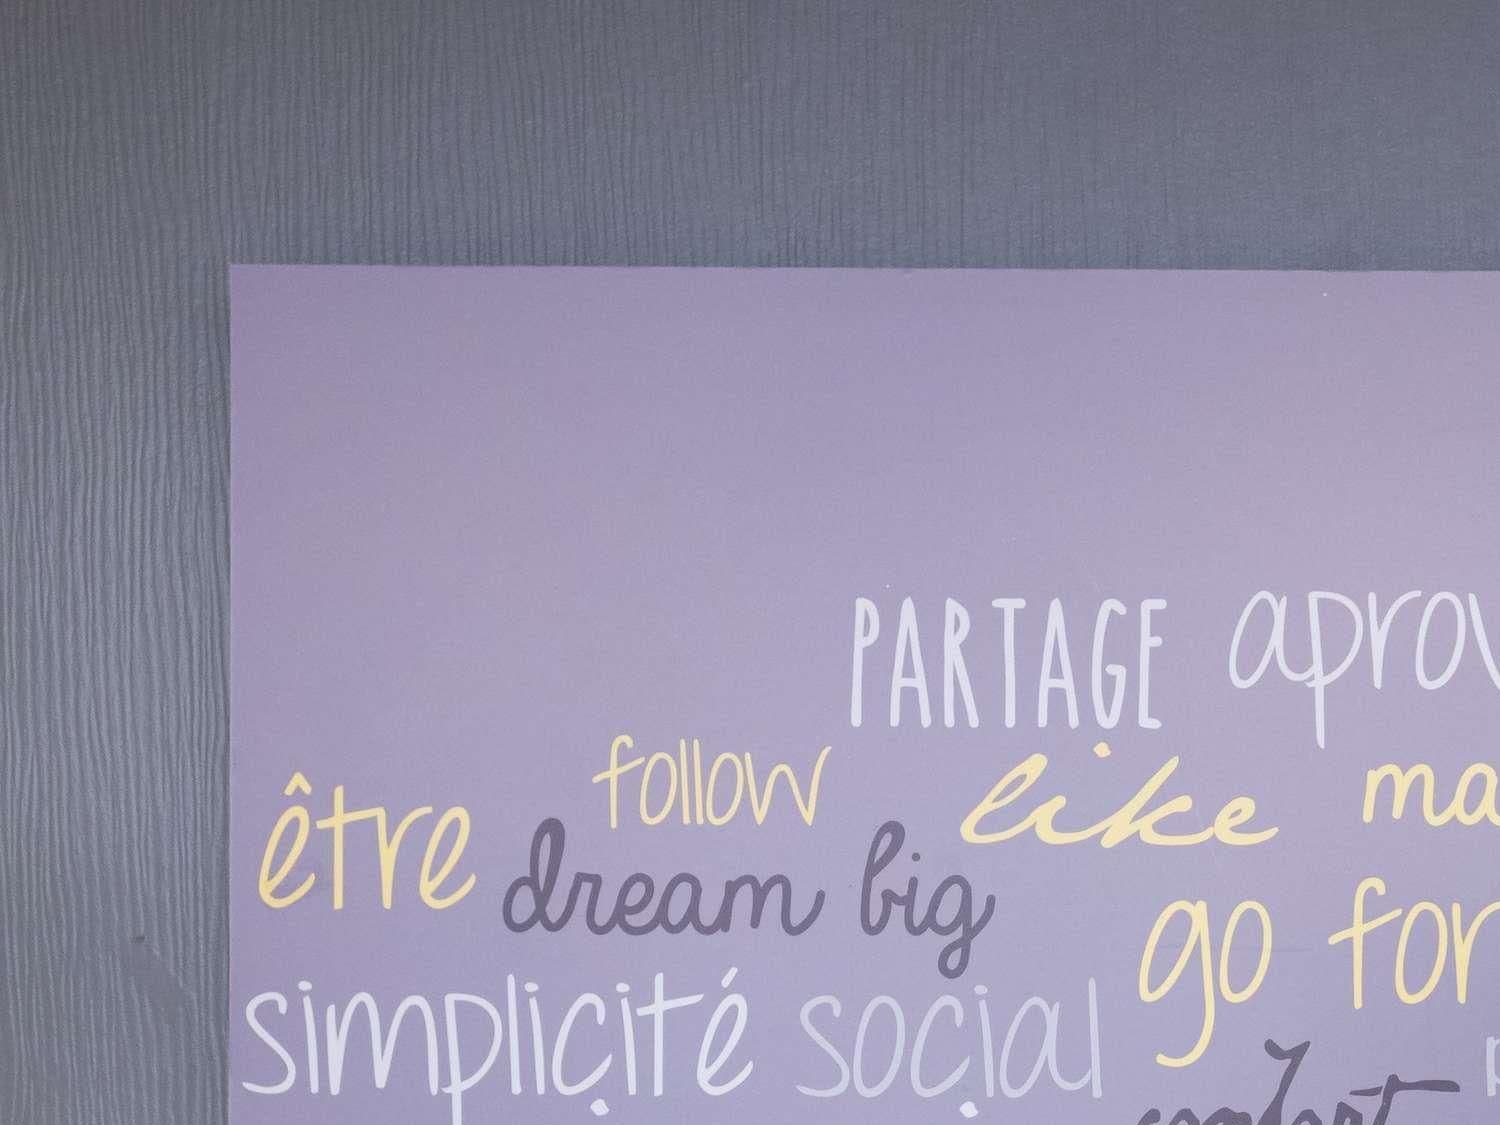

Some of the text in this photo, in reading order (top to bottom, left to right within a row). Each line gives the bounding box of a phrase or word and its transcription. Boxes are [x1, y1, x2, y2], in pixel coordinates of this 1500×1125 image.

[850, 596, 1168, 730] PARTAGE
[258, 771, 477, 910] être
[591, 734, 832, 829] follow
[959, 741, 1279, 849] like
[502, 817, 996, 980] dream big
[795, 977, 1104, 1101] social
[1138, 899, 1272, 1069] go
